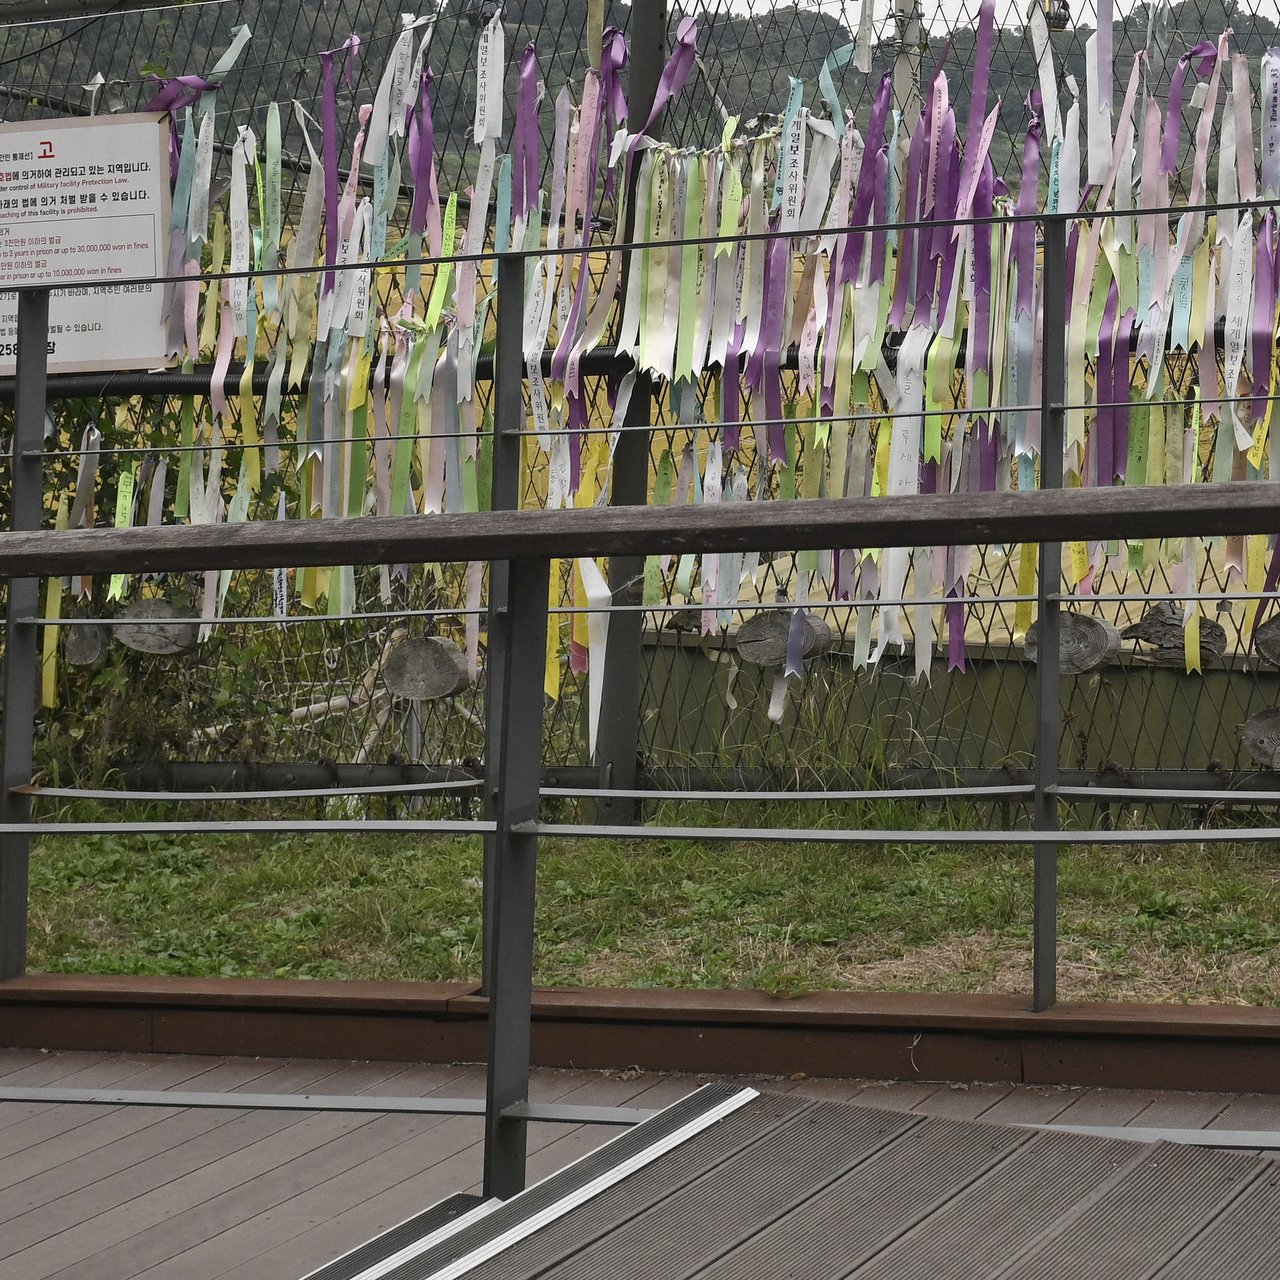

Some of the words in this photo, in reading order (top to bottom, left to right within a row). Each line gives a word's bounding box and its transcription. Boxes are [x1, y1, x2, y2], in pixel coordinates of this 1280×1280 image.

[38, 141, 55, 159] 고
[22, 168, 52, 180] 의거하여
[55, 166, 86, 178] 관리되고
[89, 165, 105, 175] 있는
[107, 162, 151, 174] 지역입니다.
[9, 183, 29, 192] control
[30, 182, 37, 190] of
[37, 181, 59, 189] Military
[60, 180, 81, 189] facility
[81, 178, 113, 187] Protection
[22, 197, 37, 208] 법에
[41, 196, 57, 206] 의거
[60, 194, 76, 205] 처벌
[80, 193, 96, 204] 받을
[100, 193, 108, 202] 수
[112, 190, 150, 202] 있습니다.
[28, 209, 39, 217] this
[40, 208, 59, 217] facility
[67, 206, 99, 215] prohibited.
[4, 237, 27, 248] 3천만원
[27, 236, 47, 245] 이하의
[49, 235, 62, 245] 벌금
[14, 250, 29, 259] years
[36, 248, 53, 257] prison
[61, 247, 69, 255] up
[77, 243, 112, 253] 30,000,000
[133, 241, 149, 249] fines
[15, 260, 33, 270] 이하의
[35, 259, 47, 268] 벌금
[13, 271, 30, 281] prison
[30, 271, 37, 279] or
[45, 270, 52, 278] to
[53, 268, 85, 278] 10,000,000
[107, 266, 122, 274] fines
[123, 284, 152, 294] 여러분의
[65, 325, 72, 333] 수
[74, 322, 104, 332] 있습니다.
